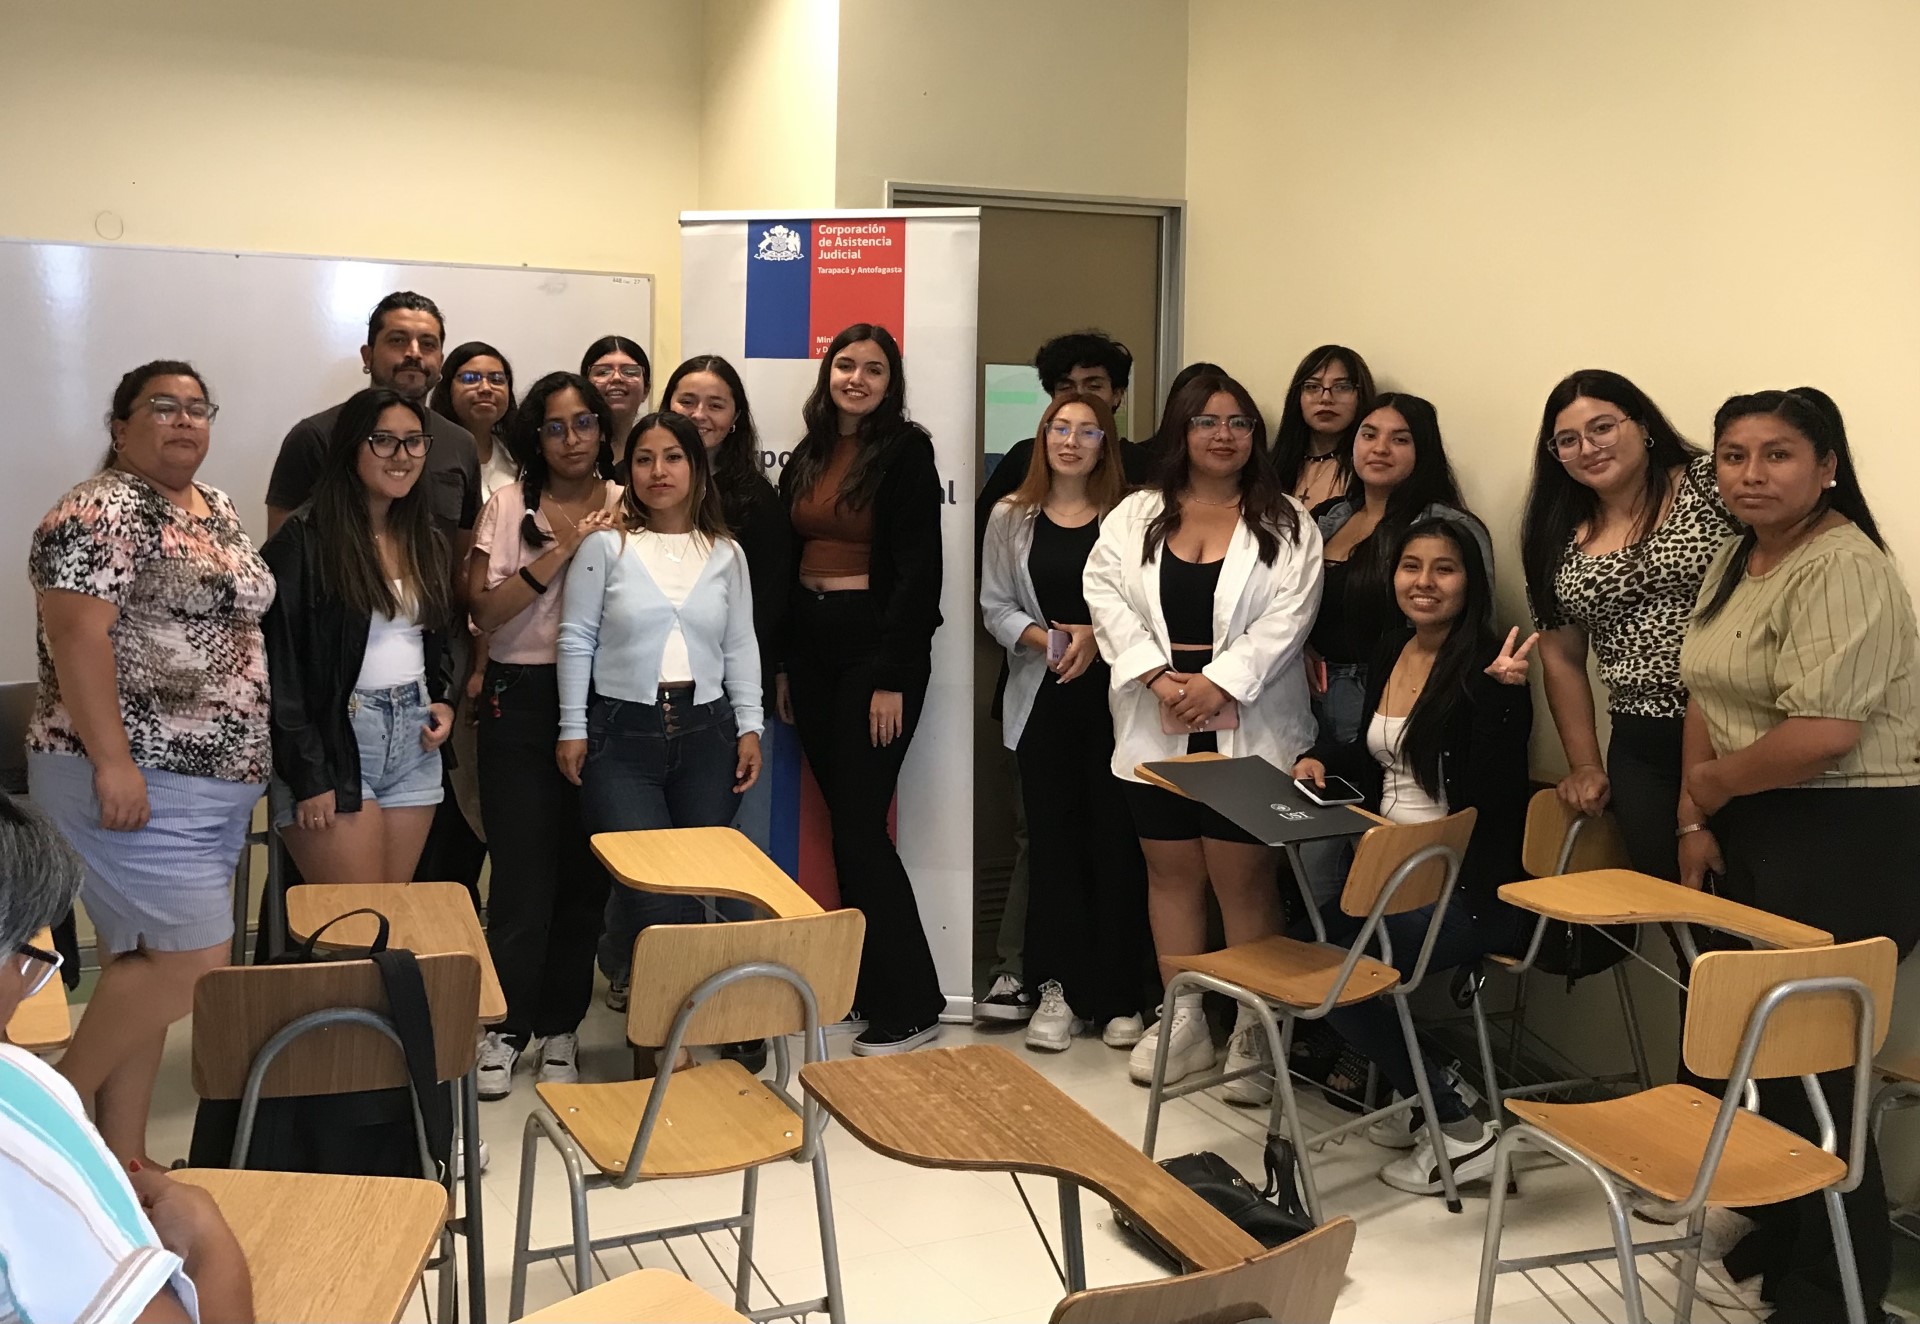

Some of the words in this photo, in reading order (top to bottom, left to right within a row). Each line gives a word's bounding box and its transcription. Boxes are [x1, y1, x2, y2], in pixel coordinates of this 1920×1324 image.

[818, 224, 886, 236] Corporación
[818, 237, 832, 247] de
[834, 236, 892, 247] Asistencia
[818, 249, 862, 260] Judicial
[817, 266, 850, 275] Tarapacá
[850, 268, 856, 276] y
[857, 265, 902, 275] Antofagasta
[816, 347, 821, 355] y
